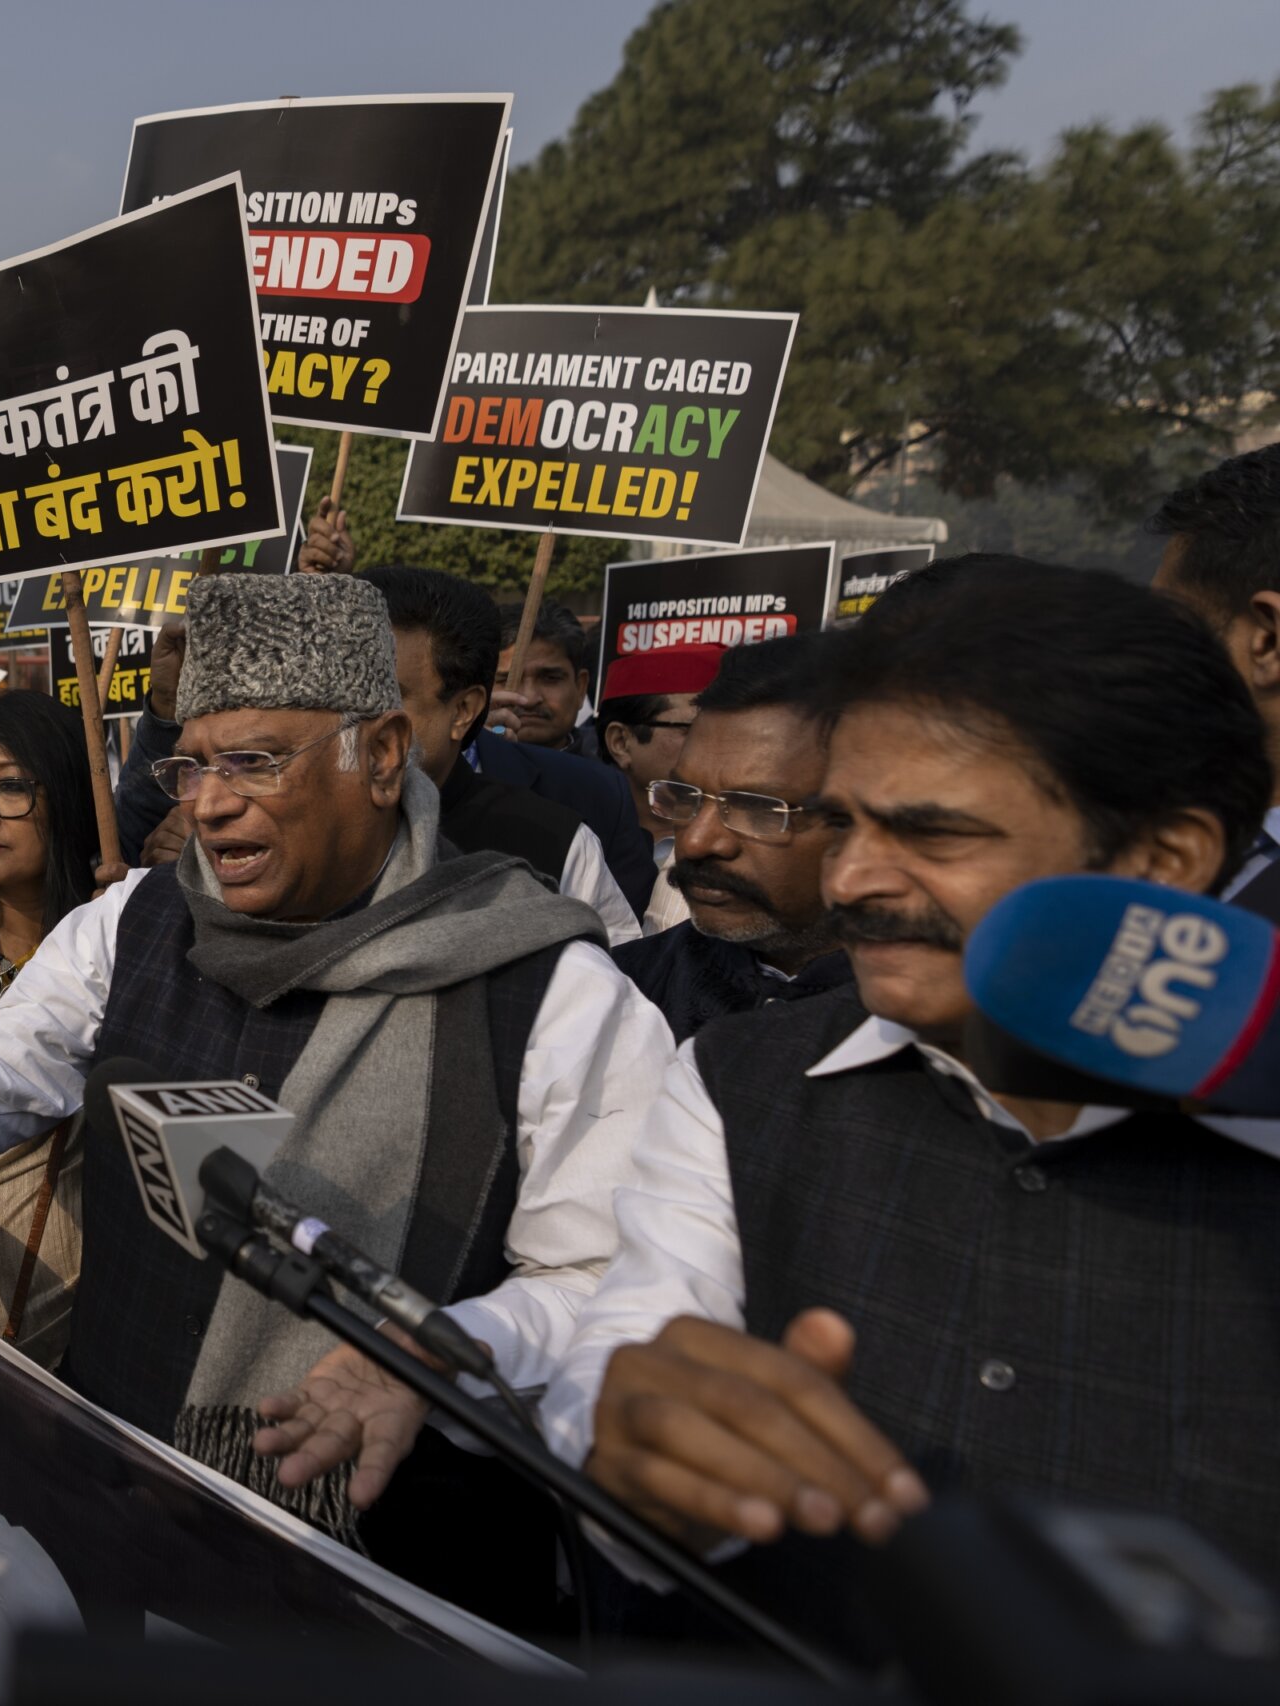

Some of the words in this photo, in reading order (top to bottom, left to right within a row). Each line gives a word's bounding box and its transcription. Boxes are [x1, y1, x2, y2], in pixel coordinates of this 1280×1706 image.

[243, 191, 344, 224] SITION
[347, 192, 418, 226] MPs
[260, 312, 328, 345] THER
[331, 318, 371, 348] OF
[120, 329, 201, 424] की
[451, 352, 642, 390] PARLIAMENT
[644, 357, 752, 396] CAGED
[442, 395, 740, 460] DEMOCRACY
[24, 463, 102, 540] बंद
[108, 429, 247, 526] करो!
[450, 456, 699, 521] EXPELLED!
[628, 602, 647, 620] 141
[649, 595, 742, 619] OPPOSITION
[744, 594, 787, 613] MPs
[622, 617, 788, 651] SUSPENDED
[157, 1086, 274, 1116] ANI
[123, 1112, 187, 1237] ANI
